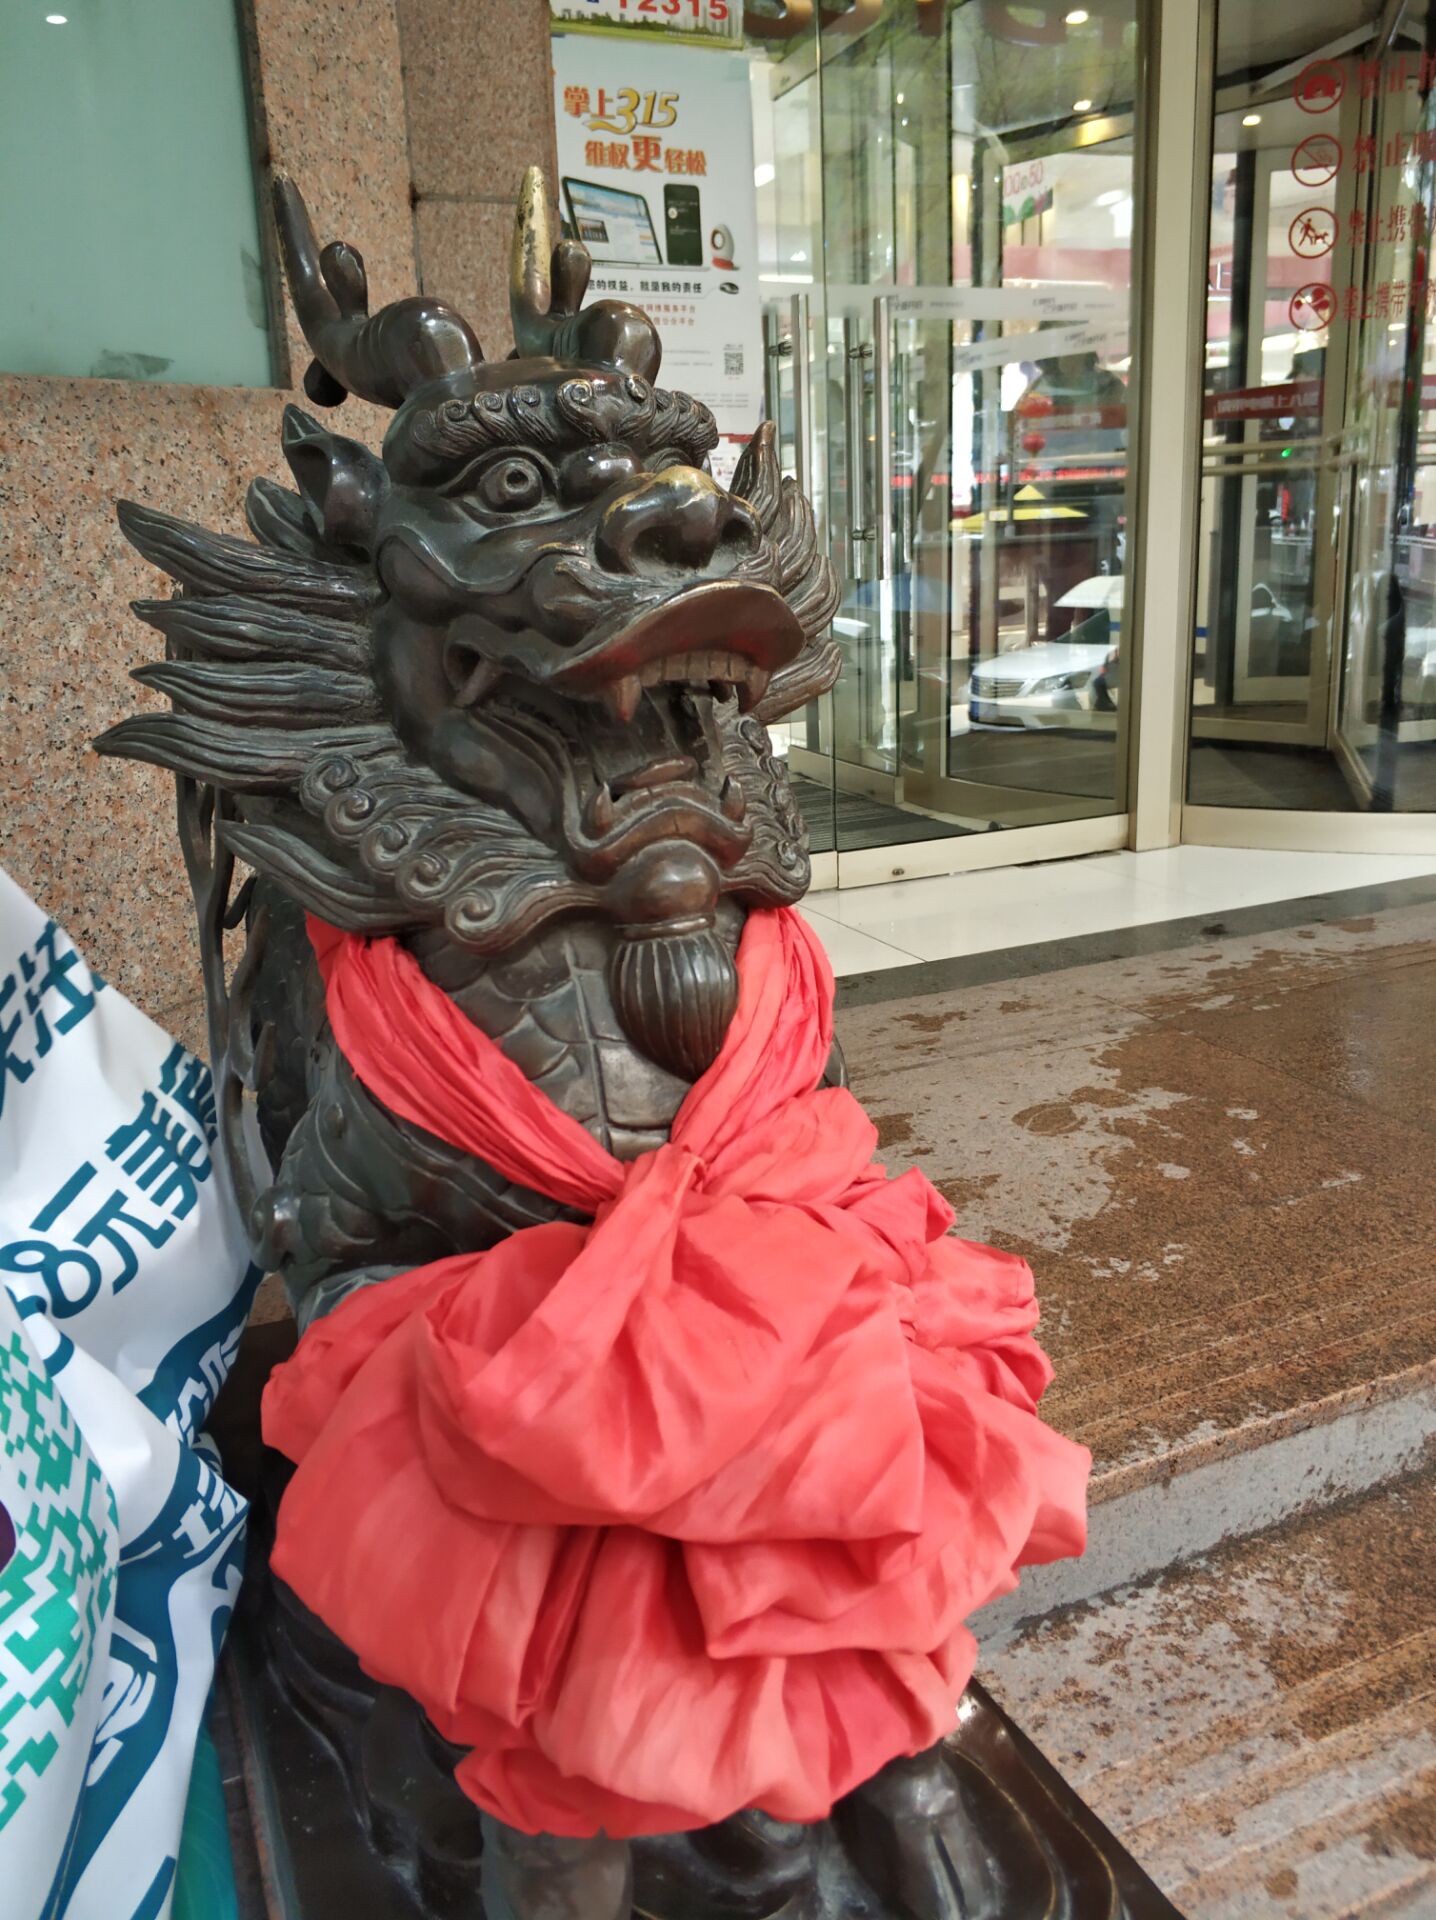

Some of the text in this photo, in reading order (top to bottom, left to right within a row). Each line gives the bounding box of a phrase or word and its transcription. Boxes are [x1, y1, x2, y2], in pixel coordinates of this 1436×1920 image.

[563, 86, 679, 135] 掌上315
[585, 134, 707, 176] 维权更轻松
[1348, 203, 1436, 246] 禁止携带
